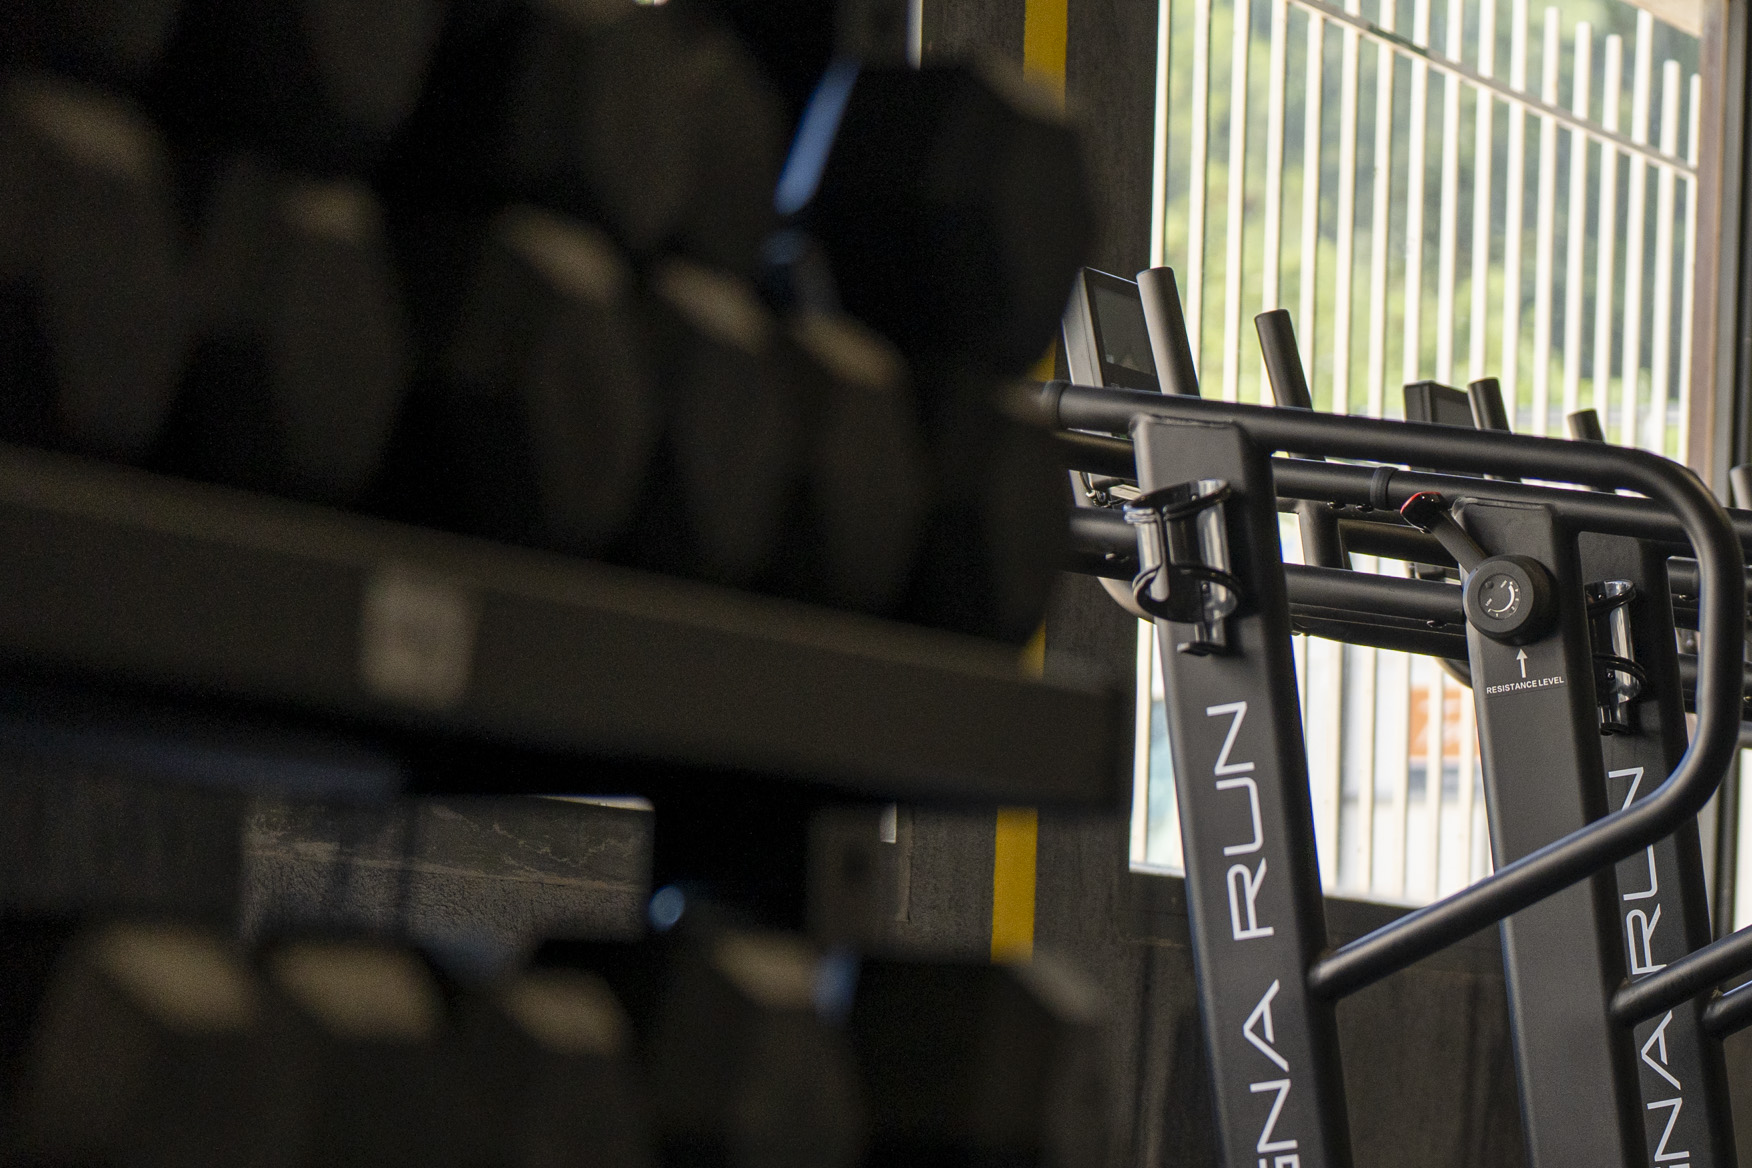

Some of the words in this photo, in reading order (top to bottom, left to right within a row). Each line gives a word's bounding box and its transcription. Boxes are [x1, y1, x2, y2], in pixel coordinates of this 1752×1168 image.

[1486, 680, 1538, 694] RESISTANCE
[1538, 676, 1565, 687] LEVEL
[1206, 701, 1275, 941] RUN
